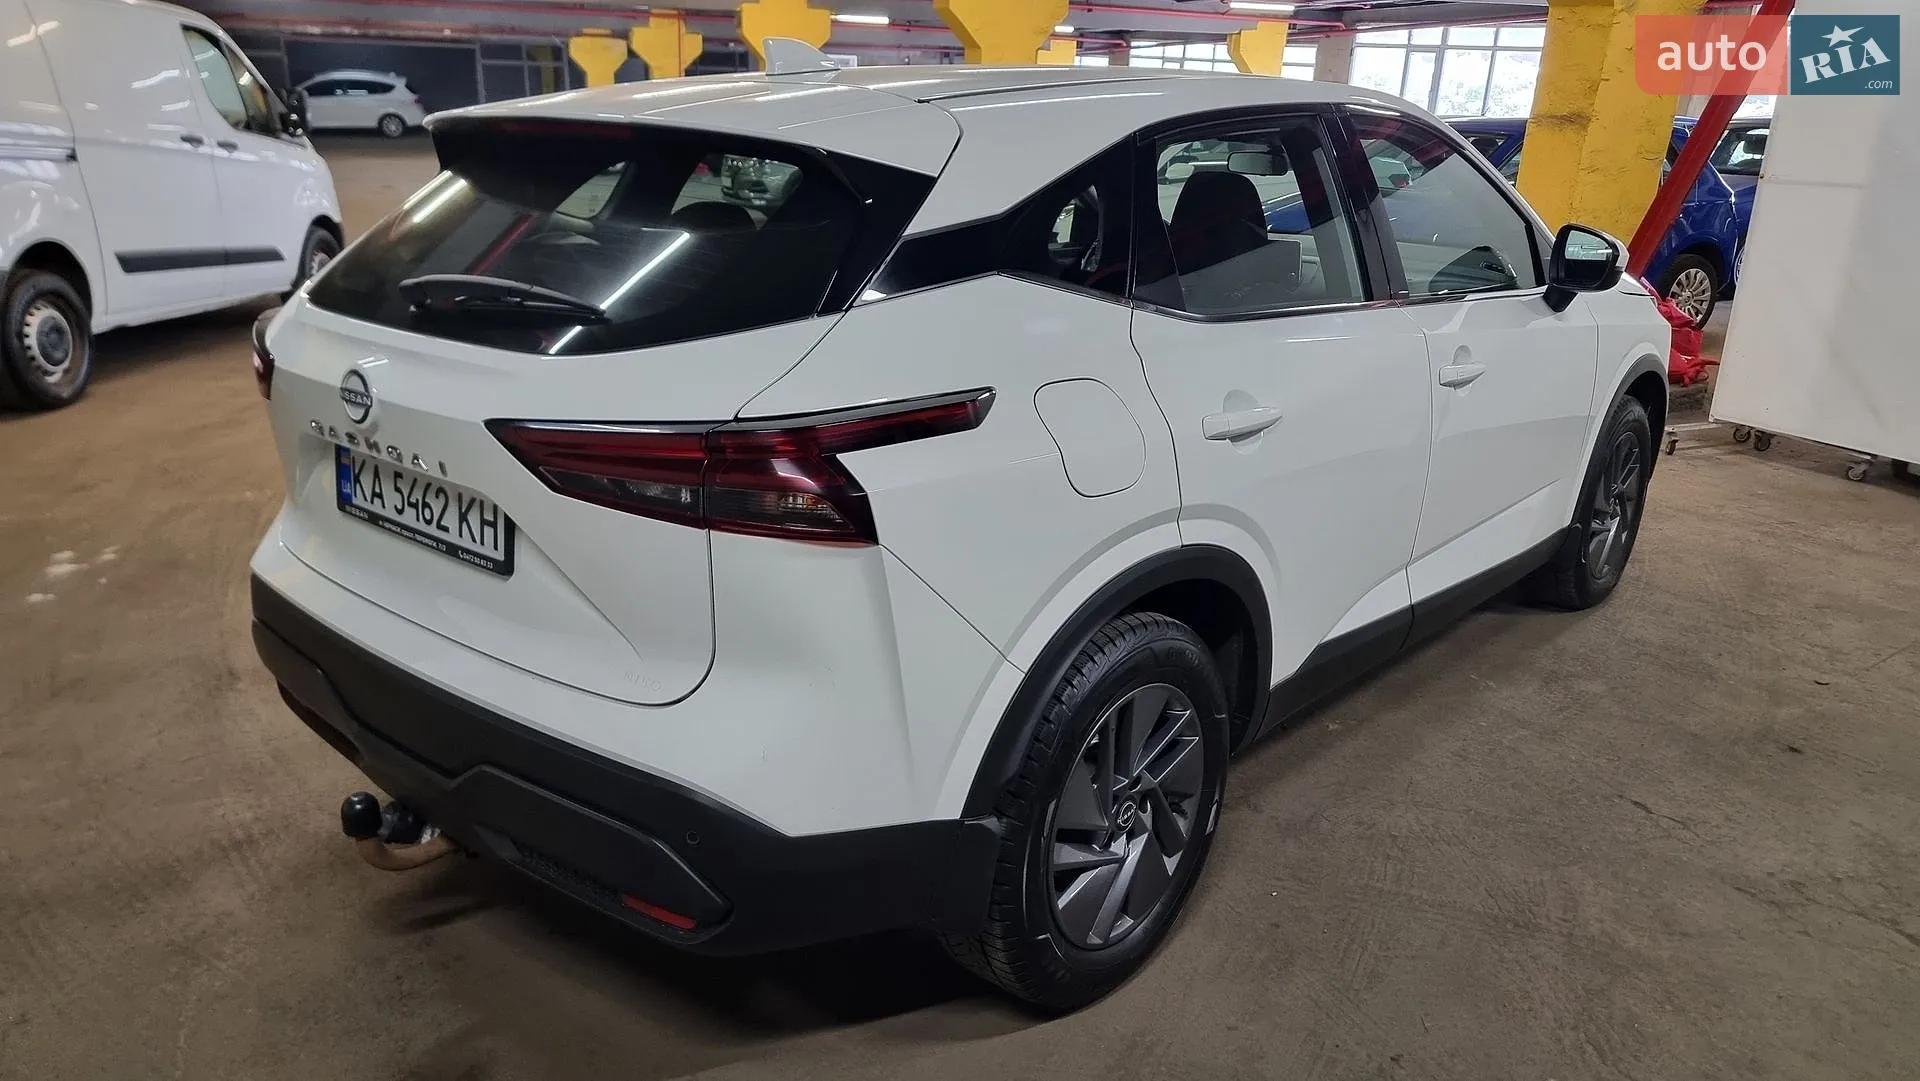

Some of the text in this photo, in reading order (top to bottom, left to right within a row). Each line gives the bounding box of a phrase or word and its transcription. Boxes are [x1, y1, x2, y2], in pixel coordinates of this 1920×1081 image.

[342, 390, 371, 406] SSAN
[351, 455, 386, 509] KA
[393, 470, 450, 534] 5462
[457, 492, 499, 551] KH
[345, 505, 369, 519] SSAN
